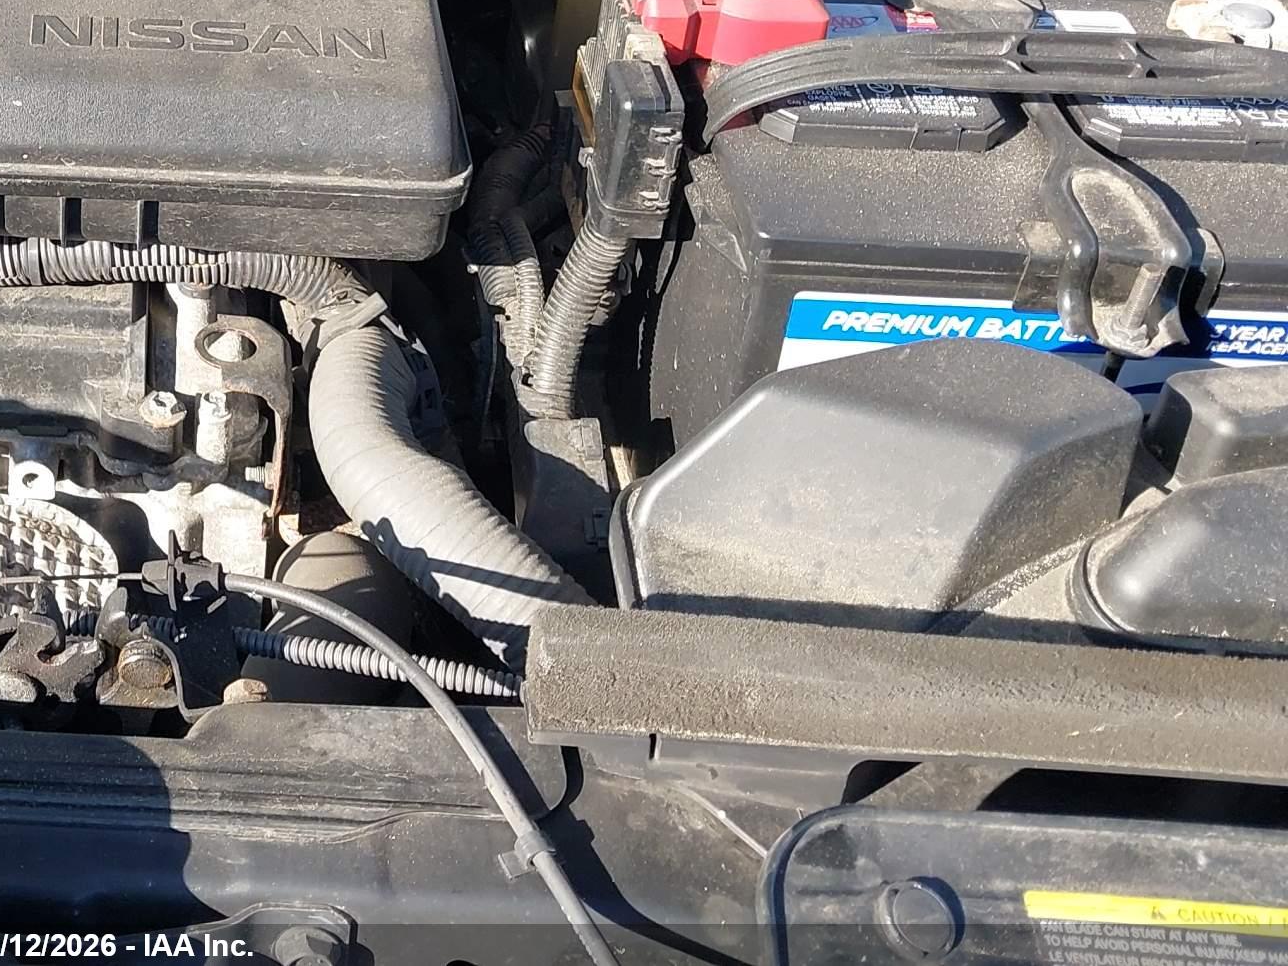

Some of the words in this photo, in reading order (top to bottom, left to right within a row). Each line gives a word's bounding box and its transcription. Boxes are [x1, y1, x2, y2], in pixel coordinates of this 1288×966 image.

[30, 14, 387, 61] NISSAN
[957, 95, 980, 103] ACID
[822, 310, 975, 338] PREMIUM
[1228, 325, 1285, 342] YEAR
[1177, 908, 1259, 928] CAUTION
[1040, 920, 1063, 932] FAN
[1064, 921, 1102, 936] BLADE
[1103, 924, 1129, 937] CAN
[1131, 926, 1166, 940] START
[1169, 930, 1182, 941] AT
[1185, 931, 1208, 943] ANY
[1044, 934, 1061, 946] TO
[1062, 935, 1092, 948] HELP
[1094, 937, 1129, 951] AVOID
[1131, 941, 1195, 957] PERSONAL
[1048, 951, 1064, 962] LE
